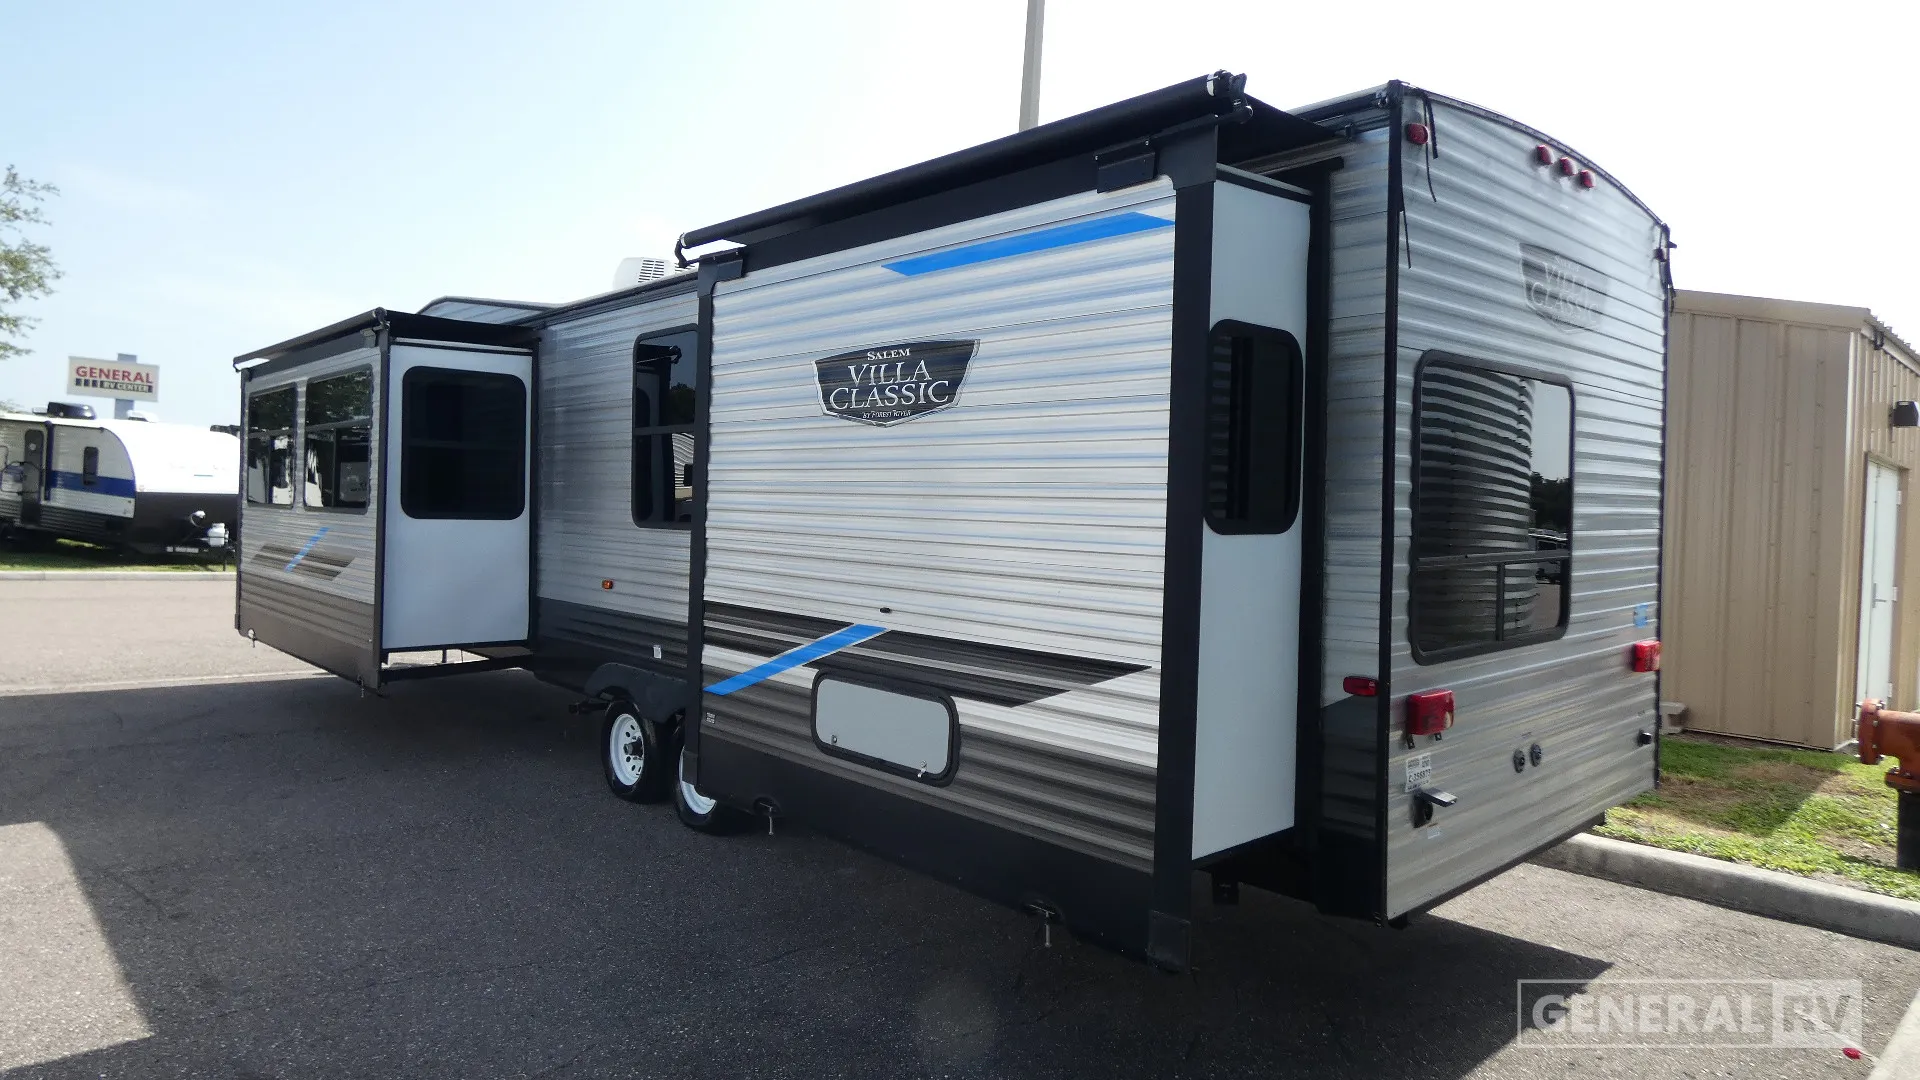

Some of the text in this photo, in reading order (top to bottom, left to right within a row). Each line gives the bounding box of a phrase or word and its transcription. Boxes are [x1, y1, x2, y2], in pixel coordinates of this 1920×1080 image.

[1532, 282, 1600, 323] CLASSIC
[867, 347, 911, 361] SALEM
[76, 366, 153, 384] GENERAL
[848, 360, 932, 387] VILLA
[104, 381, 116, 390] RV
[829, 380, 949, 410] CLASSIC
